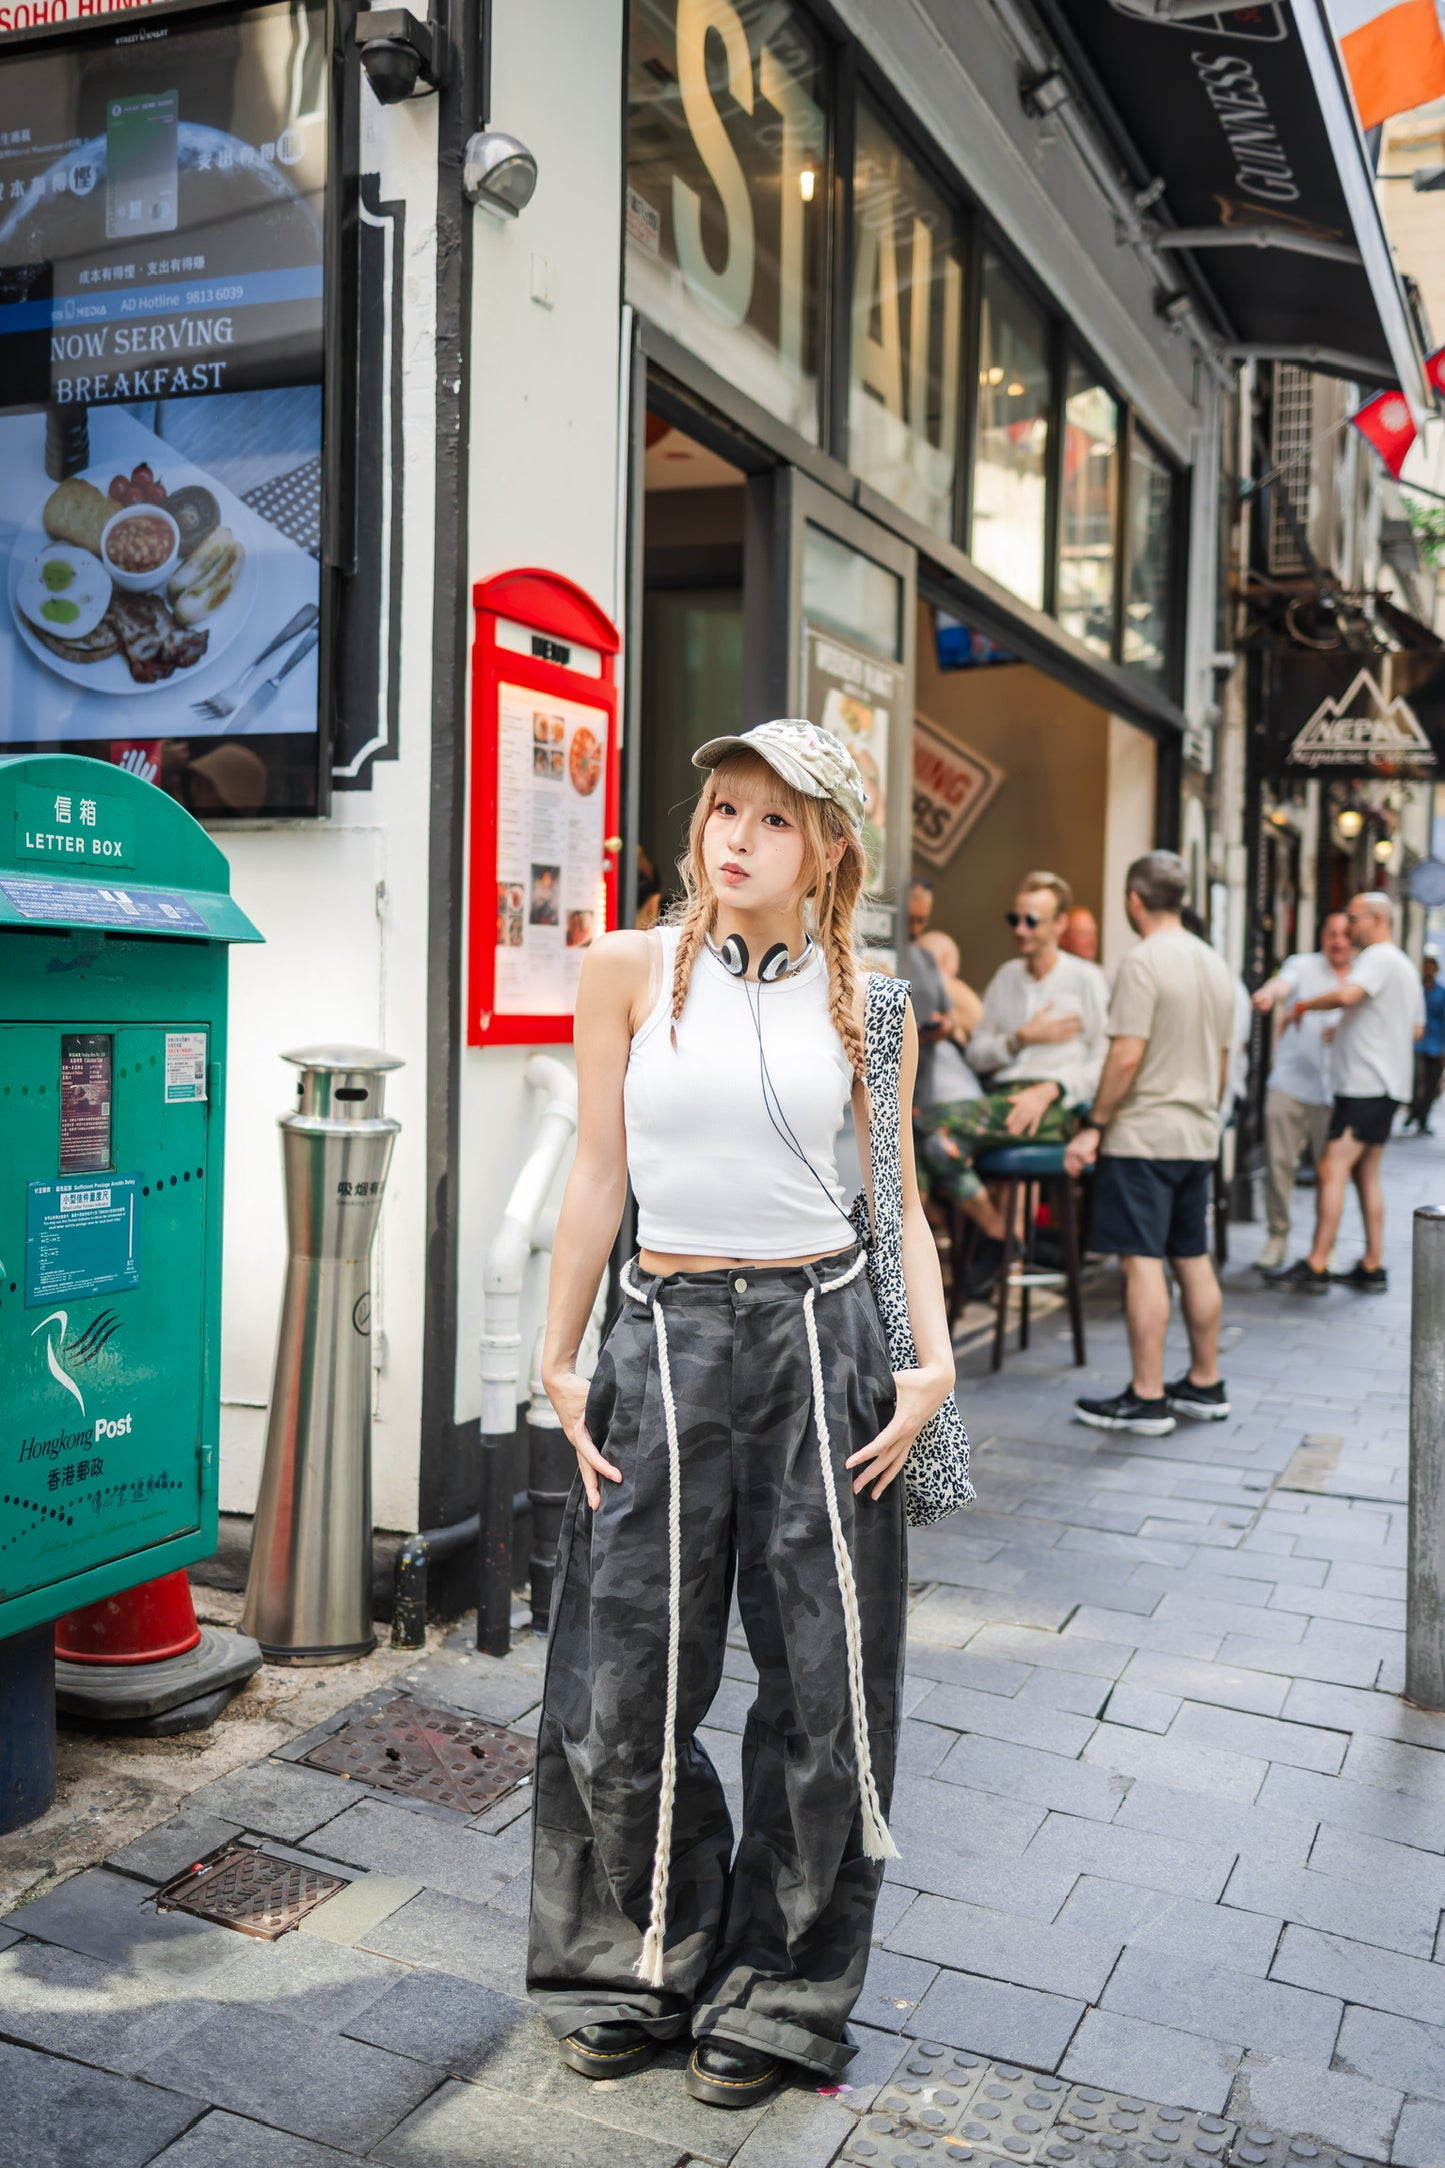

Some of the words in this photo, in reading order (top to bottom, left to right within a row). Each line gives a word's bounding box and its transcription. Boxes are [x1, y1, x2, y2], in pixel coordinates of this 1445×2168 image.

[1191, 52, 1299, 201] GUINNESS
[139, 294, 179, 310] Hotline
[186, 289, 213, 305] 9813
[215, 285, 244, 300] 6039
[50, 326, 109, 362] NOW
[114, 317, 234, 355] SERVING
[57, 362, 227, 404] BREAKFAST
[1310, 717, 1413, 745] NEPAL
[54, 795, 97, 827] 信箱
[25, 832, 85, 854] LETTER
[92, 839, 123, 857] BOX
[18, 1428, 93, 1463] Hongkong
[95, 1411, 133, 1442] Post
[47, 1456, 104, 1492] 香港郵政
